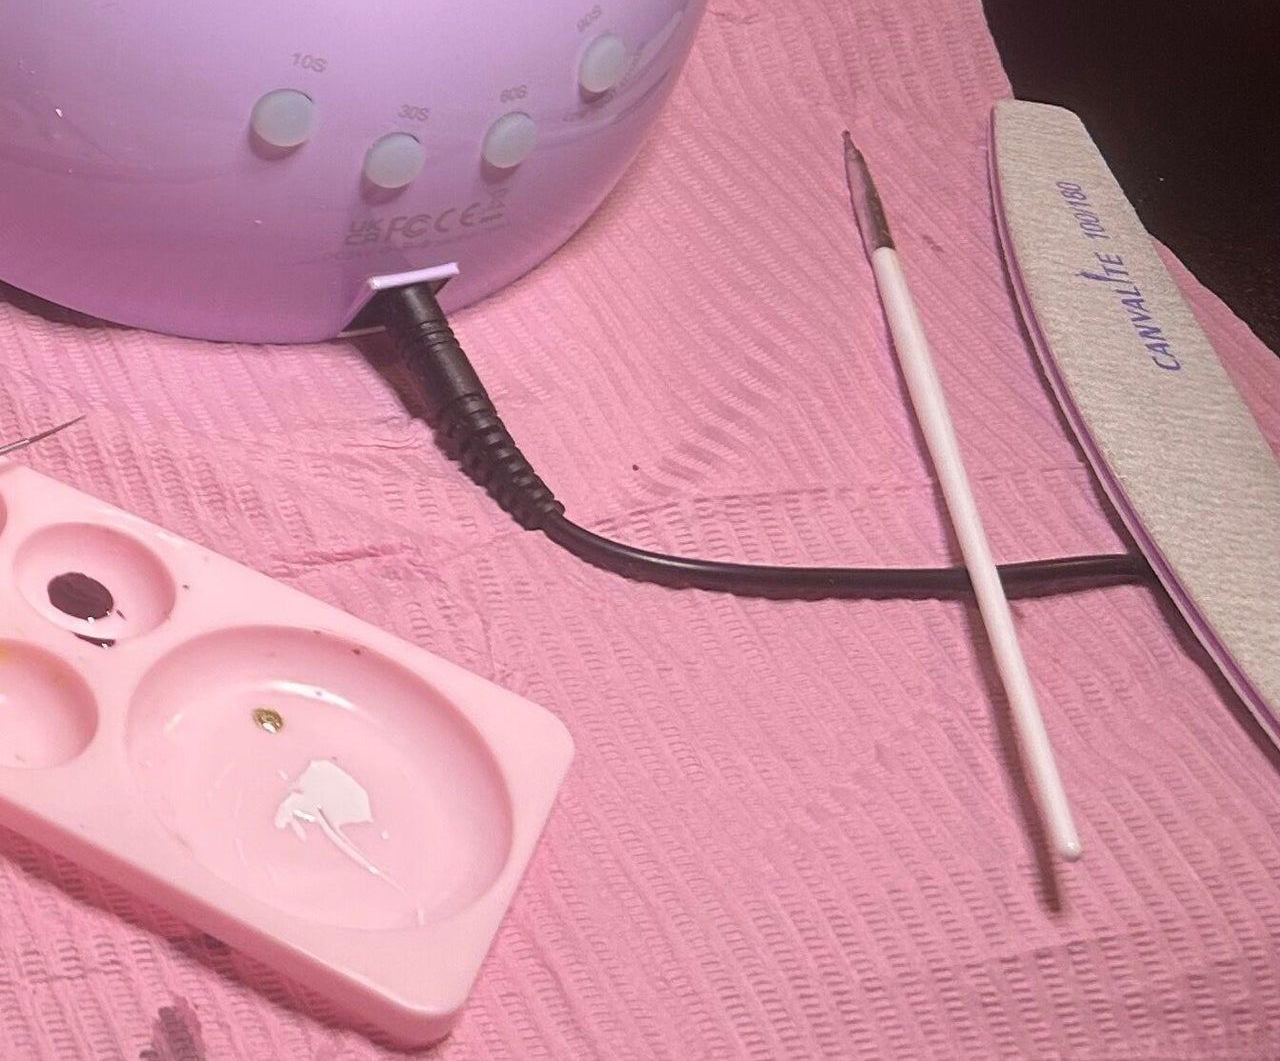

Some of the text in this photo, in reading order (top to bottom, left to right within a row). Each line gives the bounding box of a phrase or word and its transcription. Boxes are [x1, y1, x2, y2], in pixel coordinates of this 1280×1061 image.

[291, 52, 327, 73] 10S
[397, 103, 430, 122] 30S
[1055, 181, 1182, 372] CANVALITE 100/180
